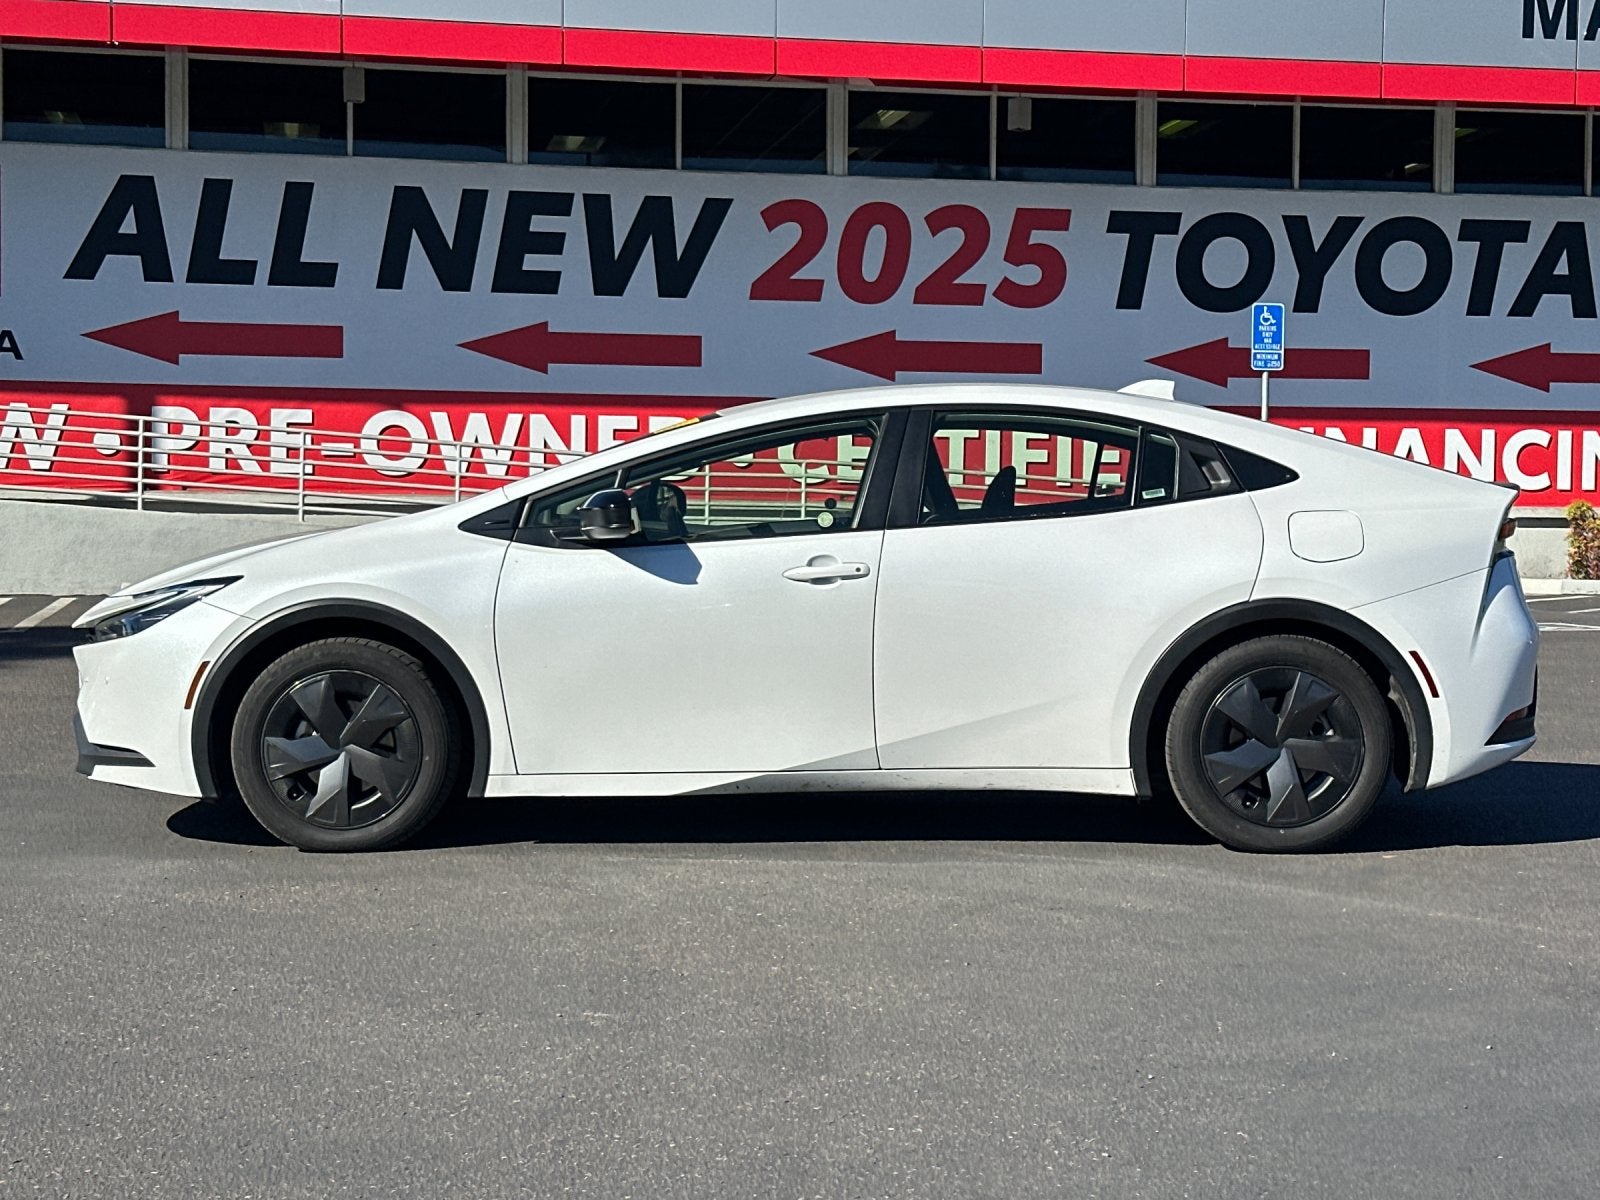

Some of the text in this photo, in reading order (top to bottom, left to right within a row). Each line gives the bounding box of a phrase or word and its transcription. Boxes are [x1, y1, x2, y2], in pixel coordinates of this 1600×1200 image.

[1521, 0, 1600, 41] M
[62, 174, 1598, 319] ALL NEW 2025 TOYOTA
